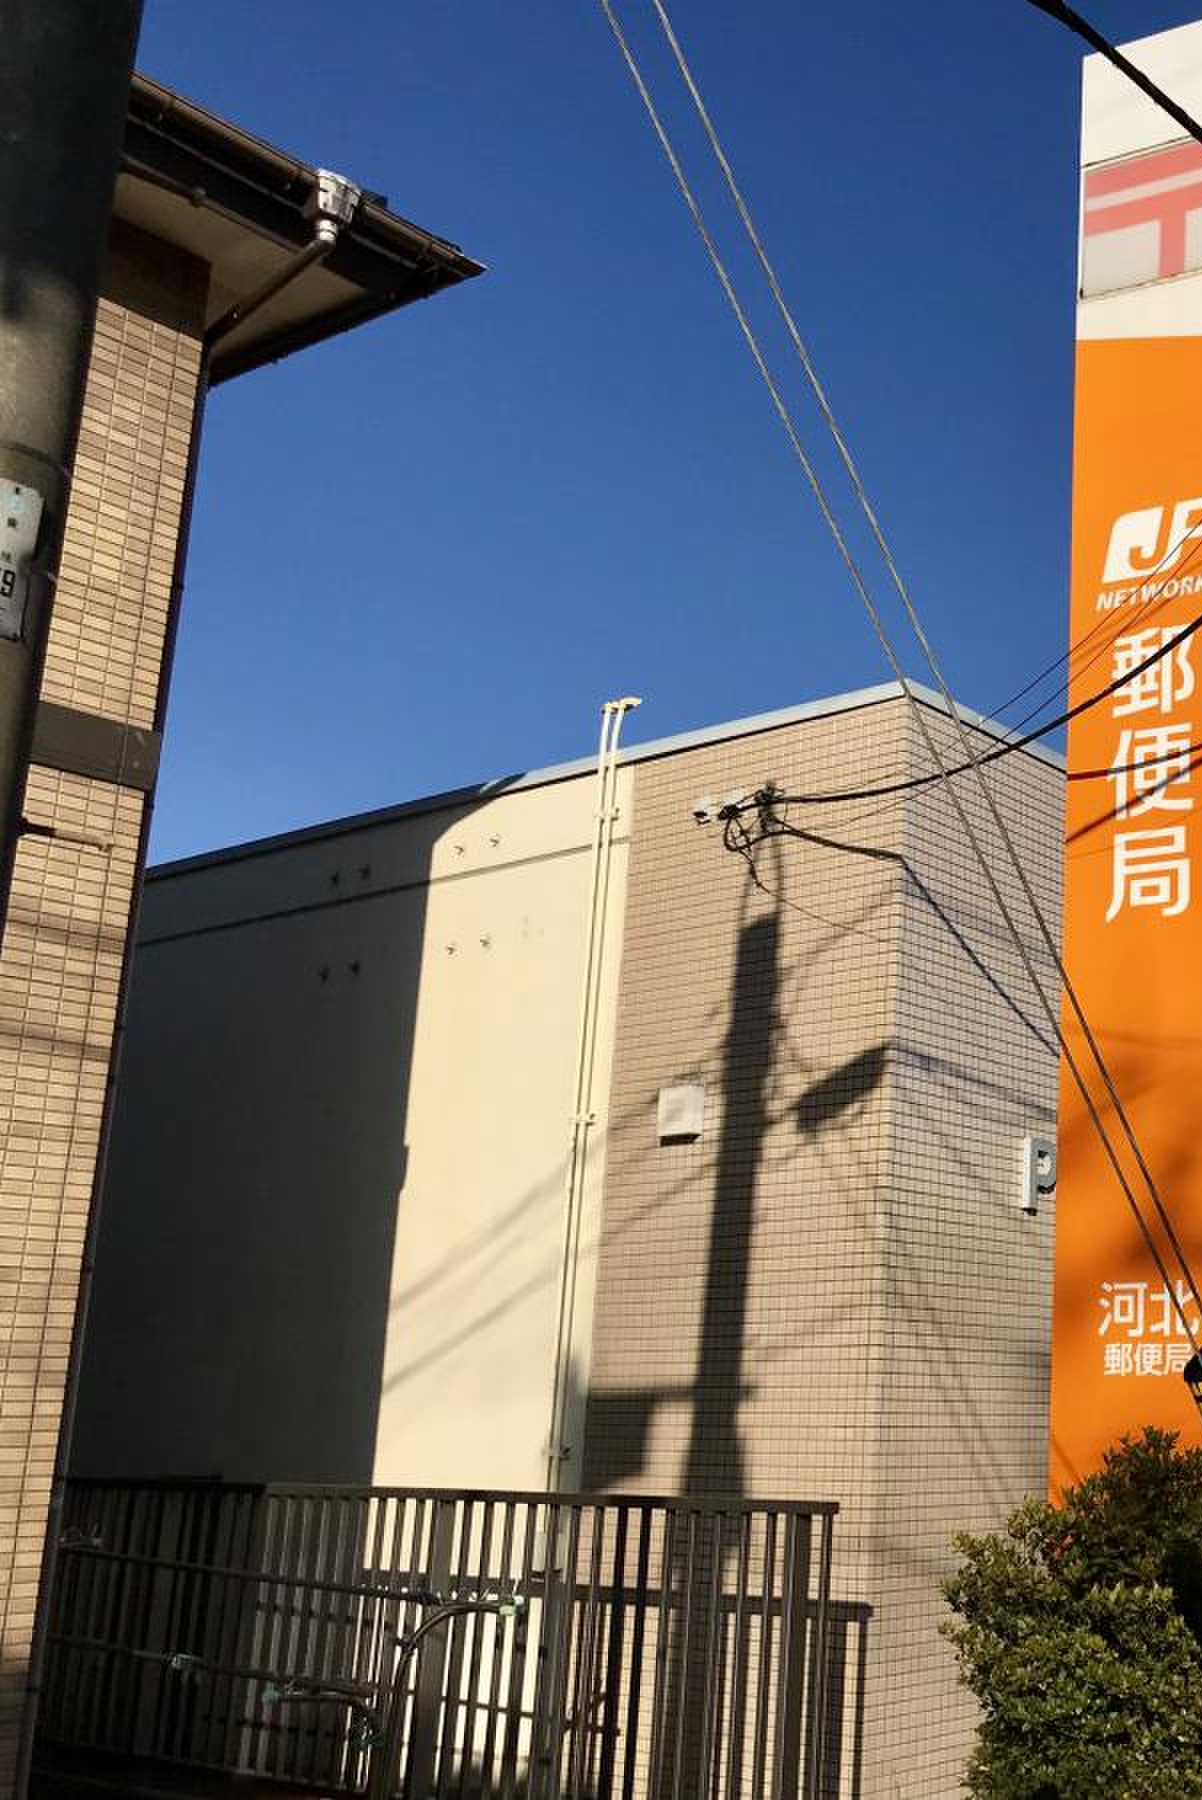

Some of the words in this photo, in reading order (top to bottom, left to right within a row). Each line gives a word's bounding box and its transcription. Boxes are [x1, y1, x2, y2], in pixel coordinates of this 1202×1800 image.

[1105, 623, 1197, 923] 郵便局
[1098, 1280, 1200, 1337] 河北
[1103, 1343, 1192, 1376] 郵便局
